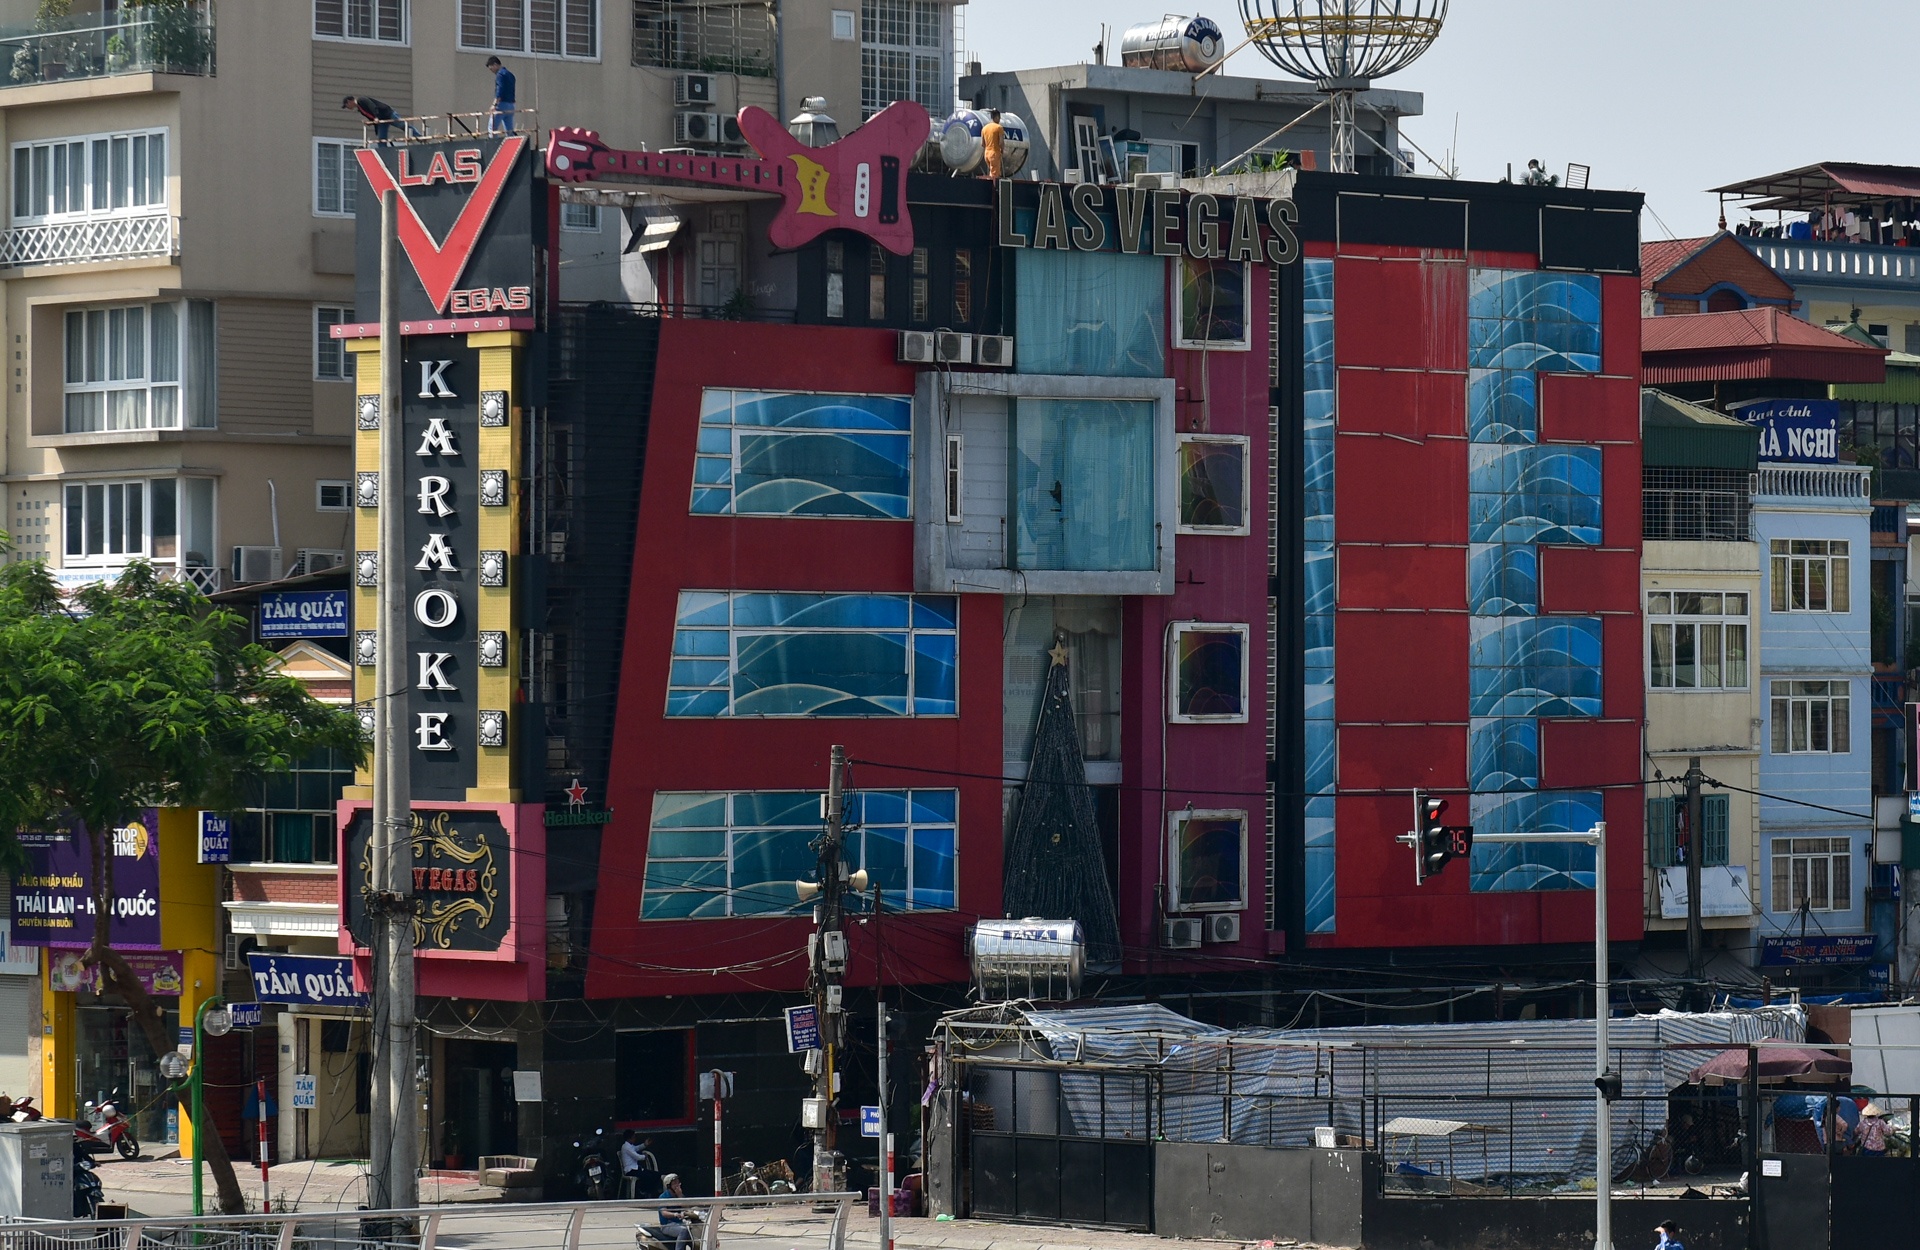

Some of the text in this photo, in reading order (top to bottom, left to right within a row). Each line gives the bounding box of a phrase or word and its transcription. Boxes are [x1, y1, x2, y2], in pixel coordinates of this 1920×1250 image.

[398, 149, 481, 186] LAS
[999, 178, 1299, 265] LAS VEGAS
[1779, 405, 1812, 418] Anh
[414, 360, 462, 752] KARAOKE
[545, 809, 613, 827] Heineken
[113, 828, 138, 843] STOP
[113, 842, 138, 856] TIME
[40, 874, 61, 889] NHẬP
[413, 867, 477, 892] VEGAS
[16, 891, 45, 913] THÁI
[48, 896, 74, 914] LAN
[118, 889, 157, 918] QUỐC
[18, 917, 42, 927] CHUYÊN
[255, 959, 301, 995] TẨM
